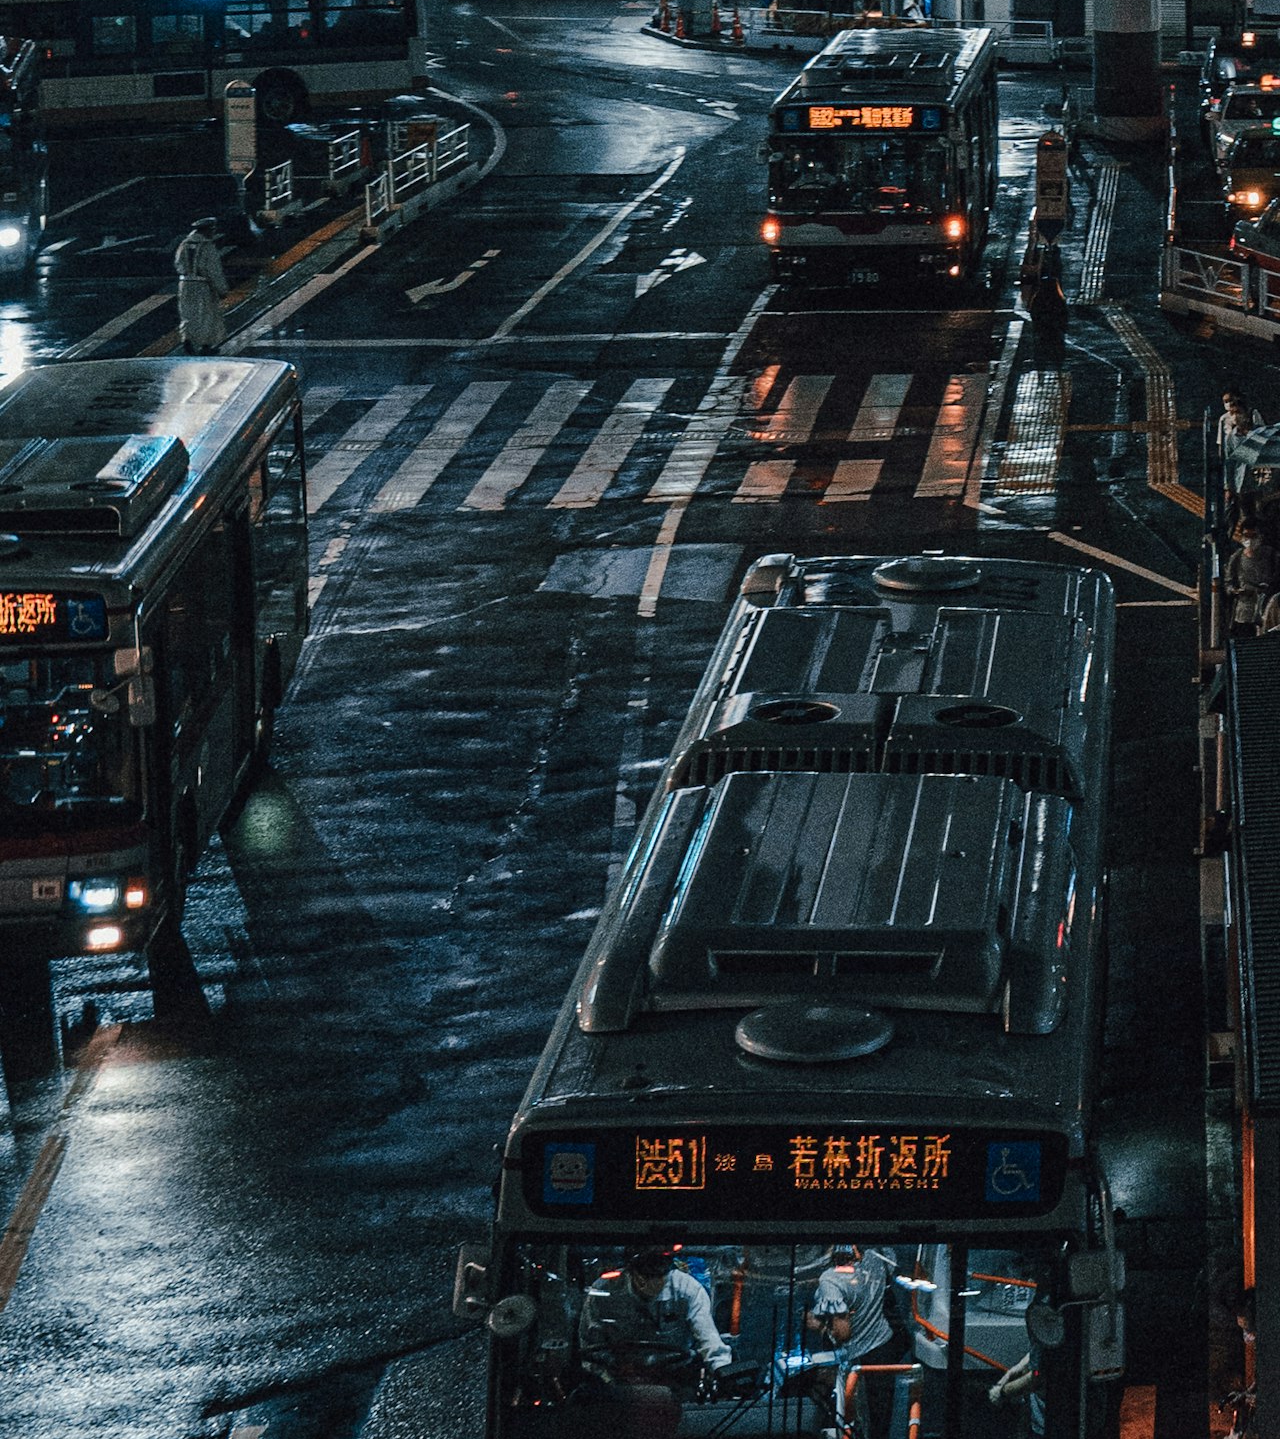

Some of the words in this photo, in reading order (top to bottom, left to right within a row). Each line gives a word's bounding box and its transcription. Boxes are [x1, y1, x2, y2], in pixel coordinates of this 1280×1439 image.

[638, 1137, 698, 1184] 渋51
[714, 1152, 774, 1171] 淡島
[788, 1134, 952, 1179] 若林折返所
[795, 1178, 940, 1190] WAKABAYASHI
